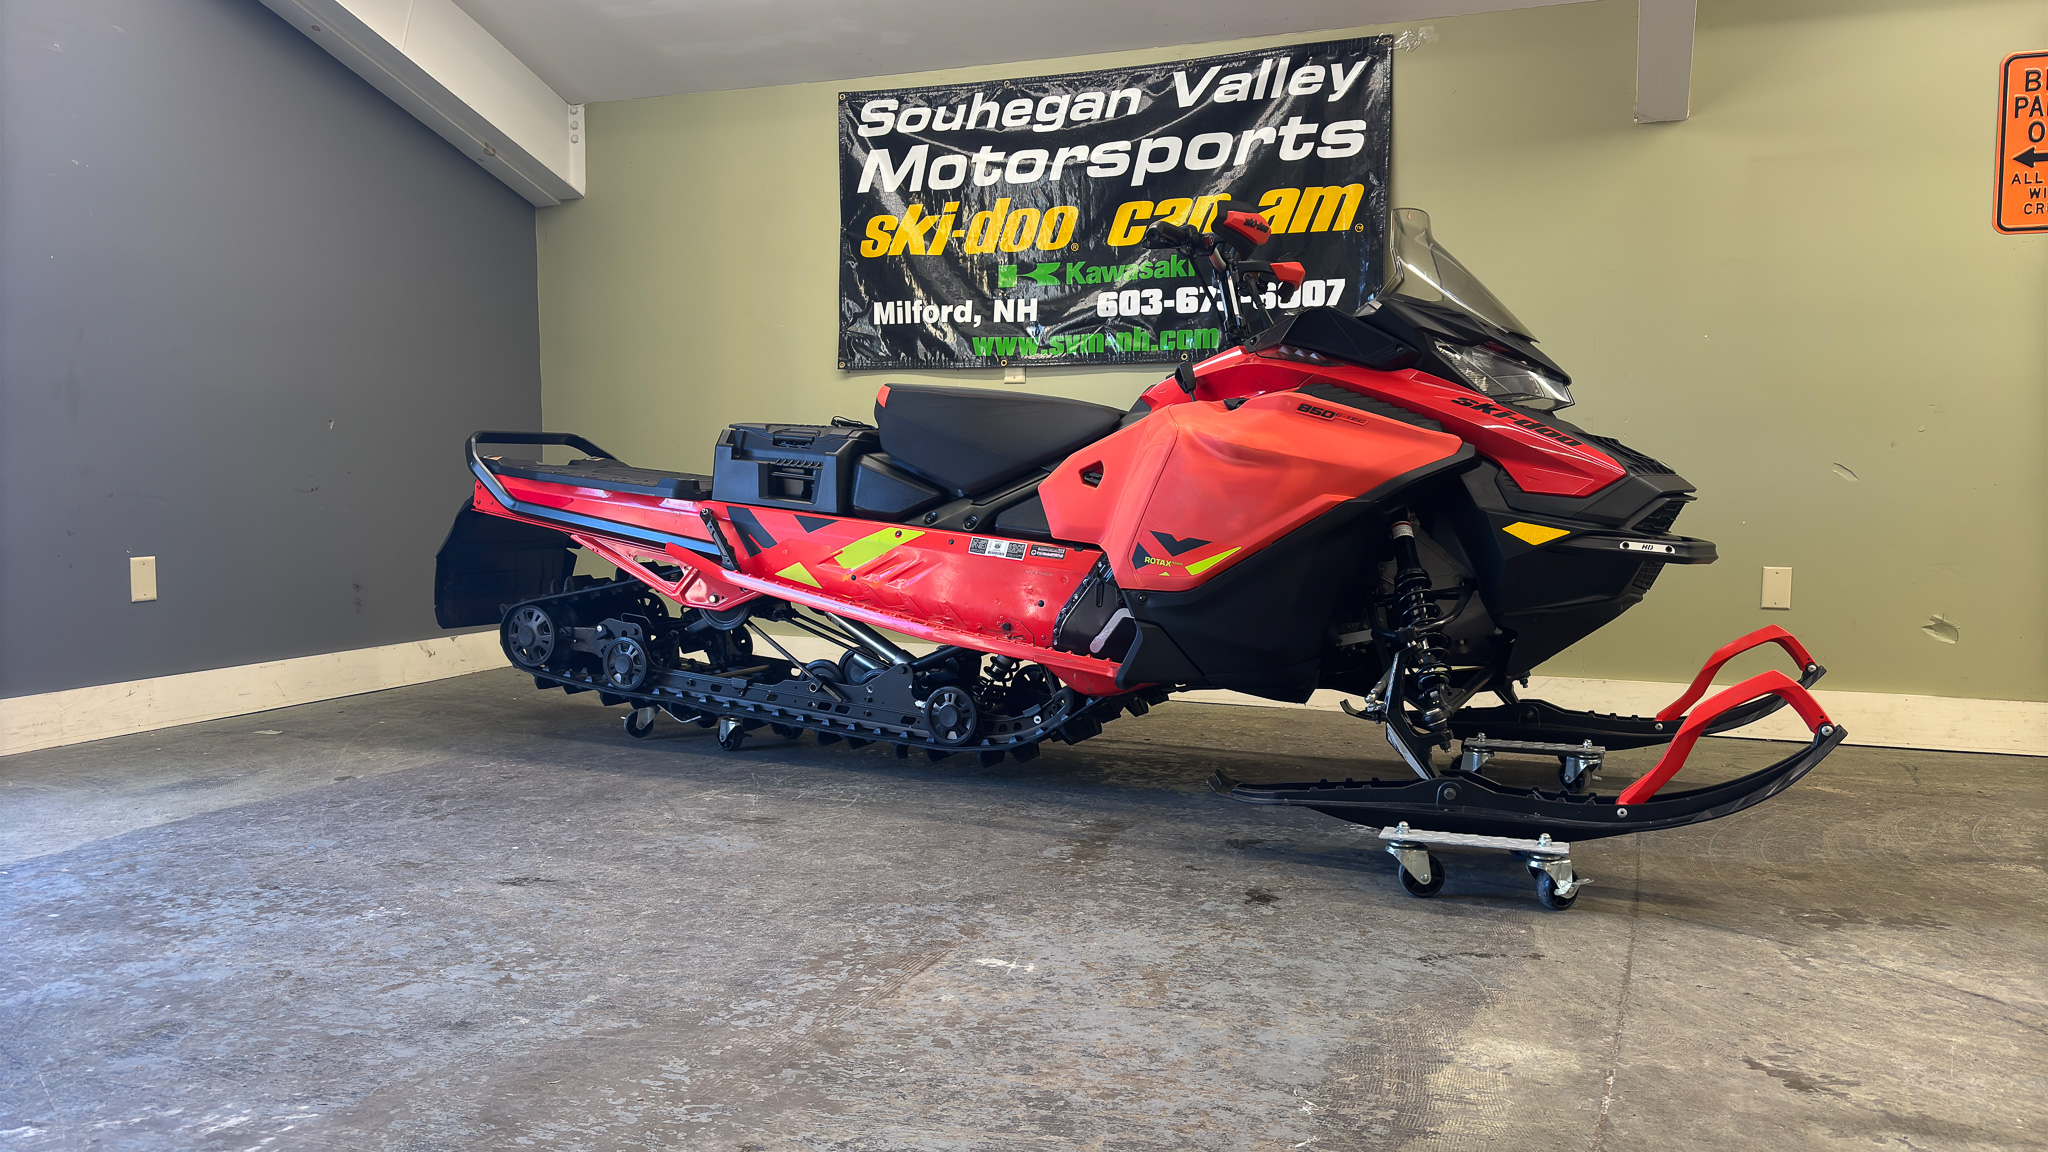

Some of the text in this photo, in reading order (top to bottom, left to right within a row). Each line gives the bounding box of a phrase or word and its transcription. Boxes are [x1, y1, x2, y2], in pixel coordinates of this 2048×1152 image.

[2025, 69, 2048, 92] B
[857, 56, 1367, 137] Souhegan Valley
[2014, 96, 2048, 118] PA
[856, 118, 1367, 193] Motorsports
[2011, 172, 2043, 185] ALL
[2024, 203, 2048, 215] CR
[860, 197, 1079, 259] ski-doo
[1065, 254, 1195, 285] Kawasaki
[873, 298, 1038, 327] Milford, NH
[972, 326, 1219, 356] www.svm-nh.com
[1297, 404, 1336, 419] 850
[1451, 397, 1583, 447] ski-doo
[1144, 556, 1171, 568] ROTAX
